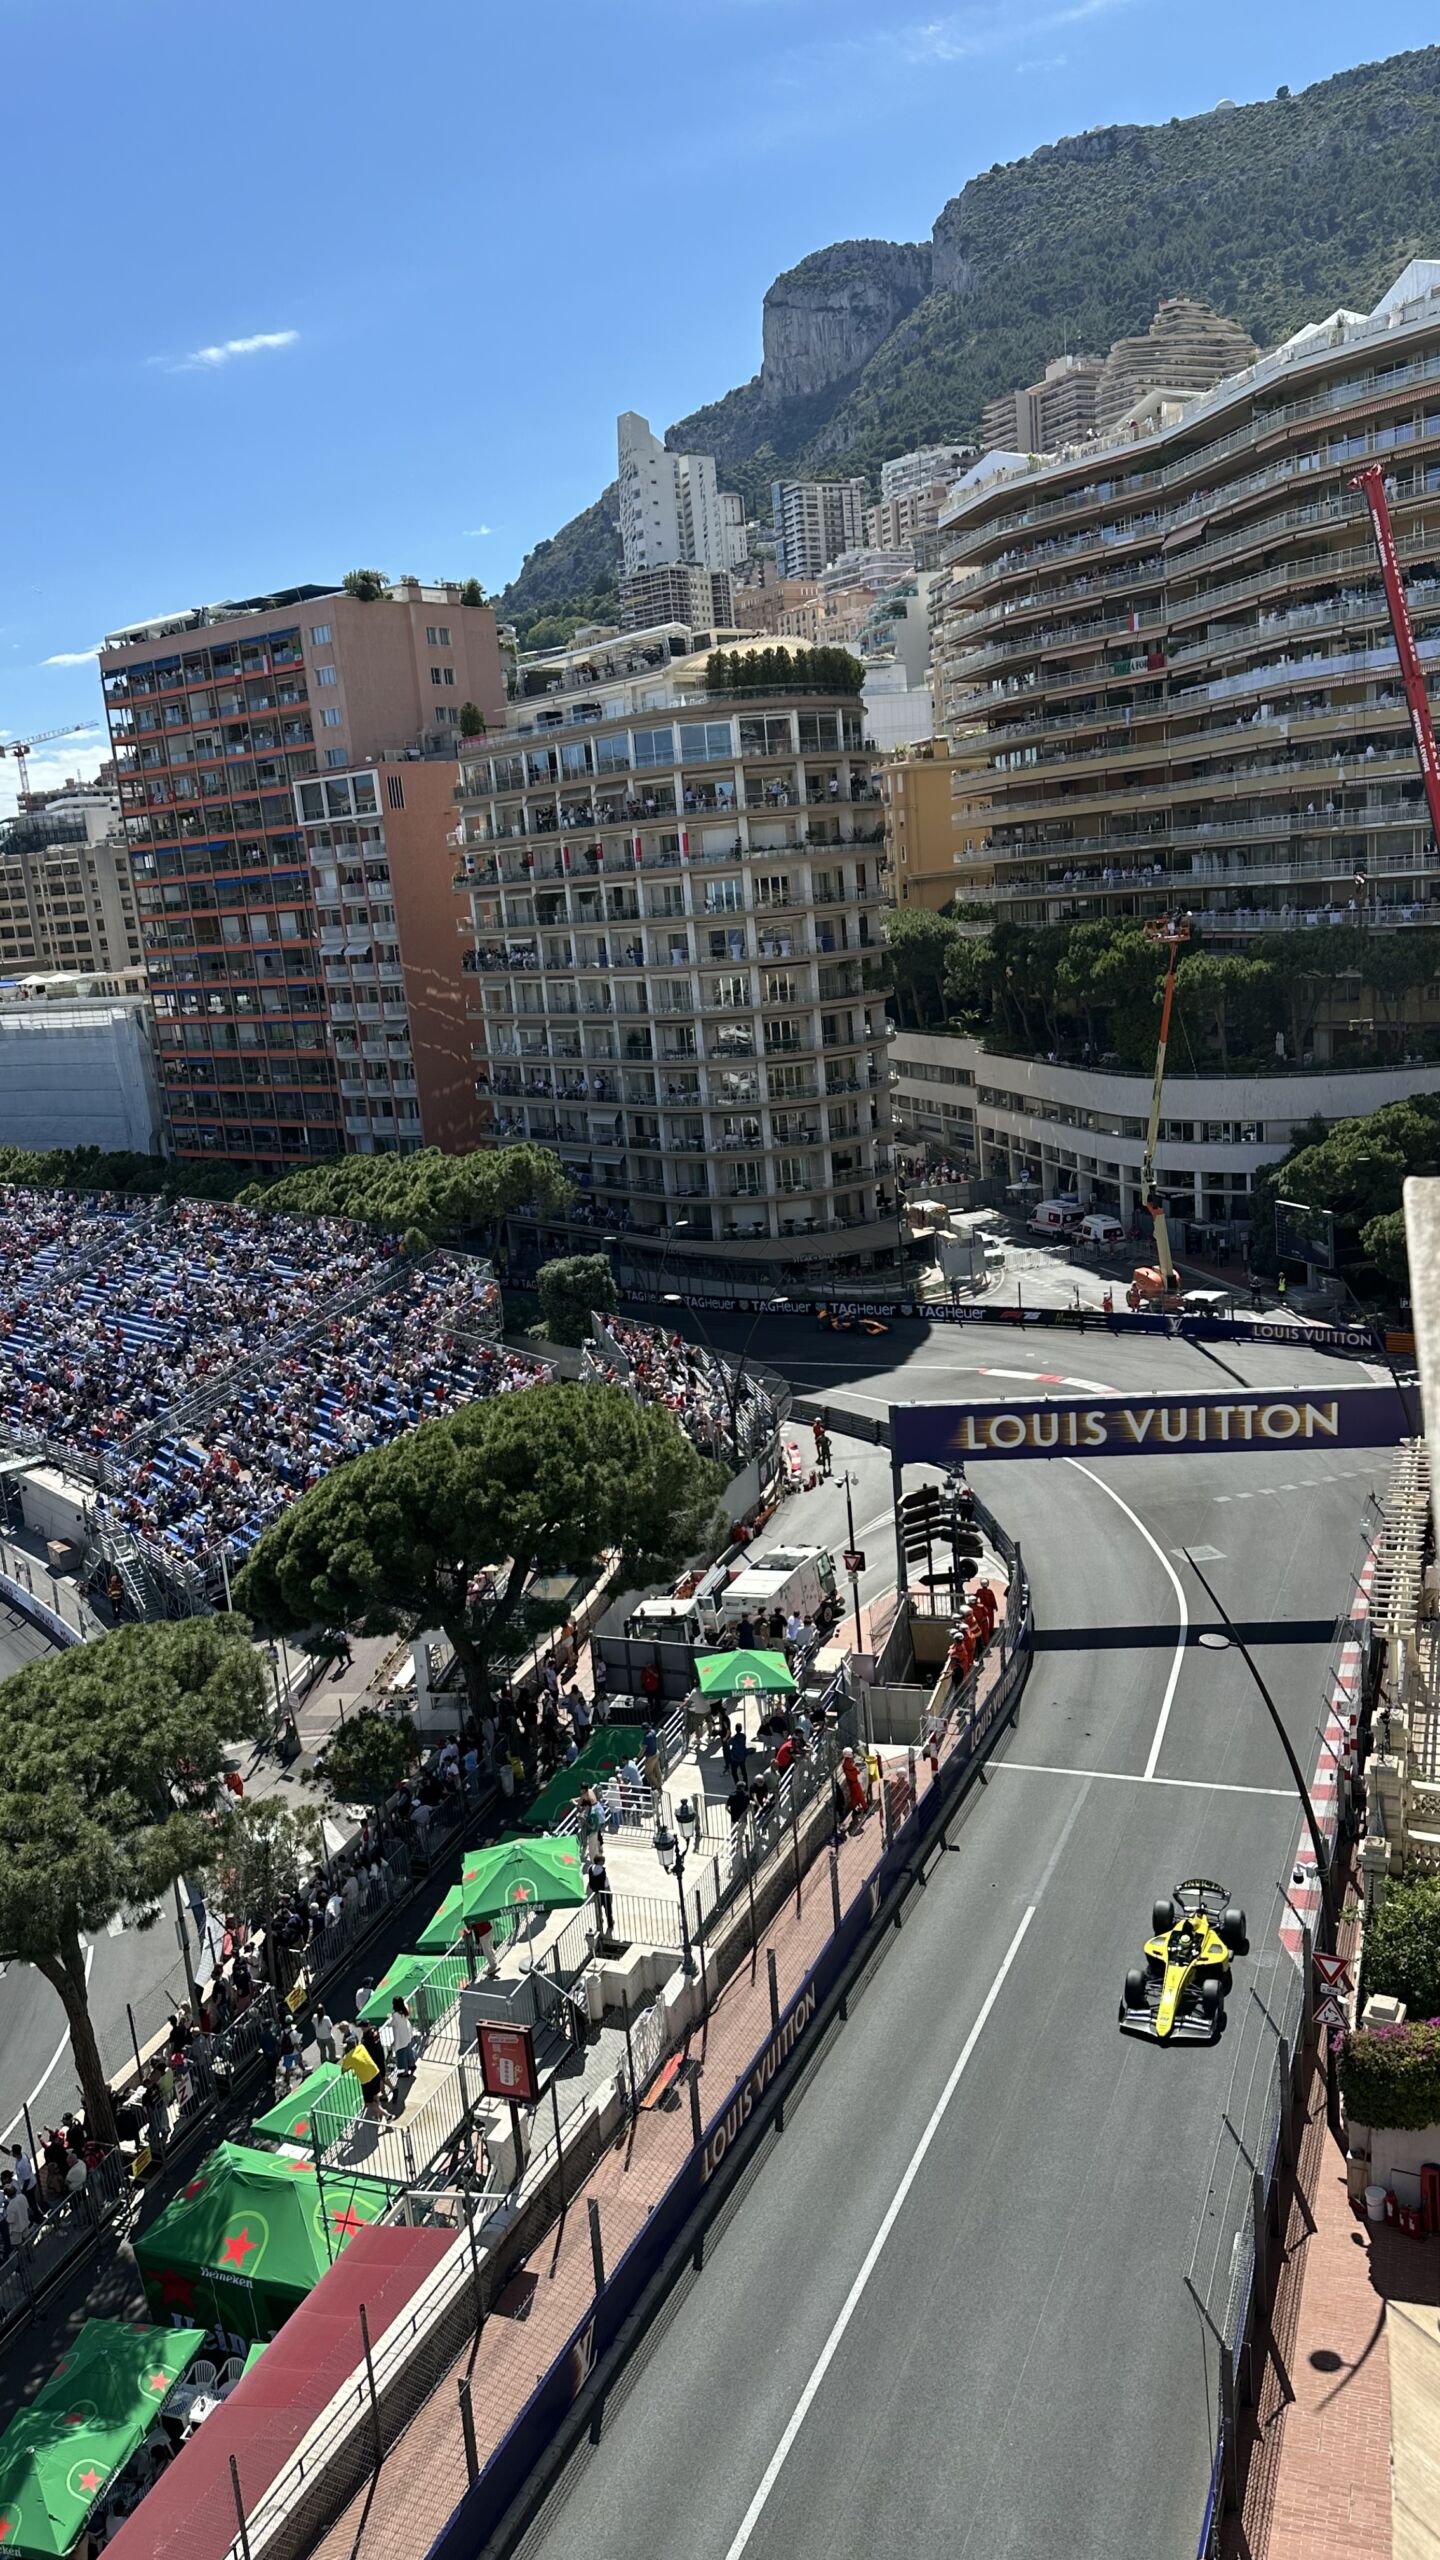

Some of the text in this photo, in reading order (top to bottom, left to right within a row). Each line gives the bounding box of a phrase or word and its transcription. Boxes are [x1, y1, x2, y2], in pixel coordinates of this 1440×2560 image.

[1387, 530, 1405, 604] IMPERIAL
[686, 1295, 736, 1311] TAGHeuer
[752, 1300, 811, 1314] TAGHeuer
[830, 1302, 896, 1317] TAGHeuer
[918, 1304, 985, 1320] TAGHeuer
[1253, 1325, 1373, 1347] LOUIS VUITTON
[965, 1401, 1339, 1451] LOUIS VUITTON
[970, 1703, 993, 1754] LOUIS
[499, 1902, 545, 1916] Heineken
[703, 1981, 817, 2183] LOUIS VUITTON
[200, 2266, 254, 2289] Heineken
